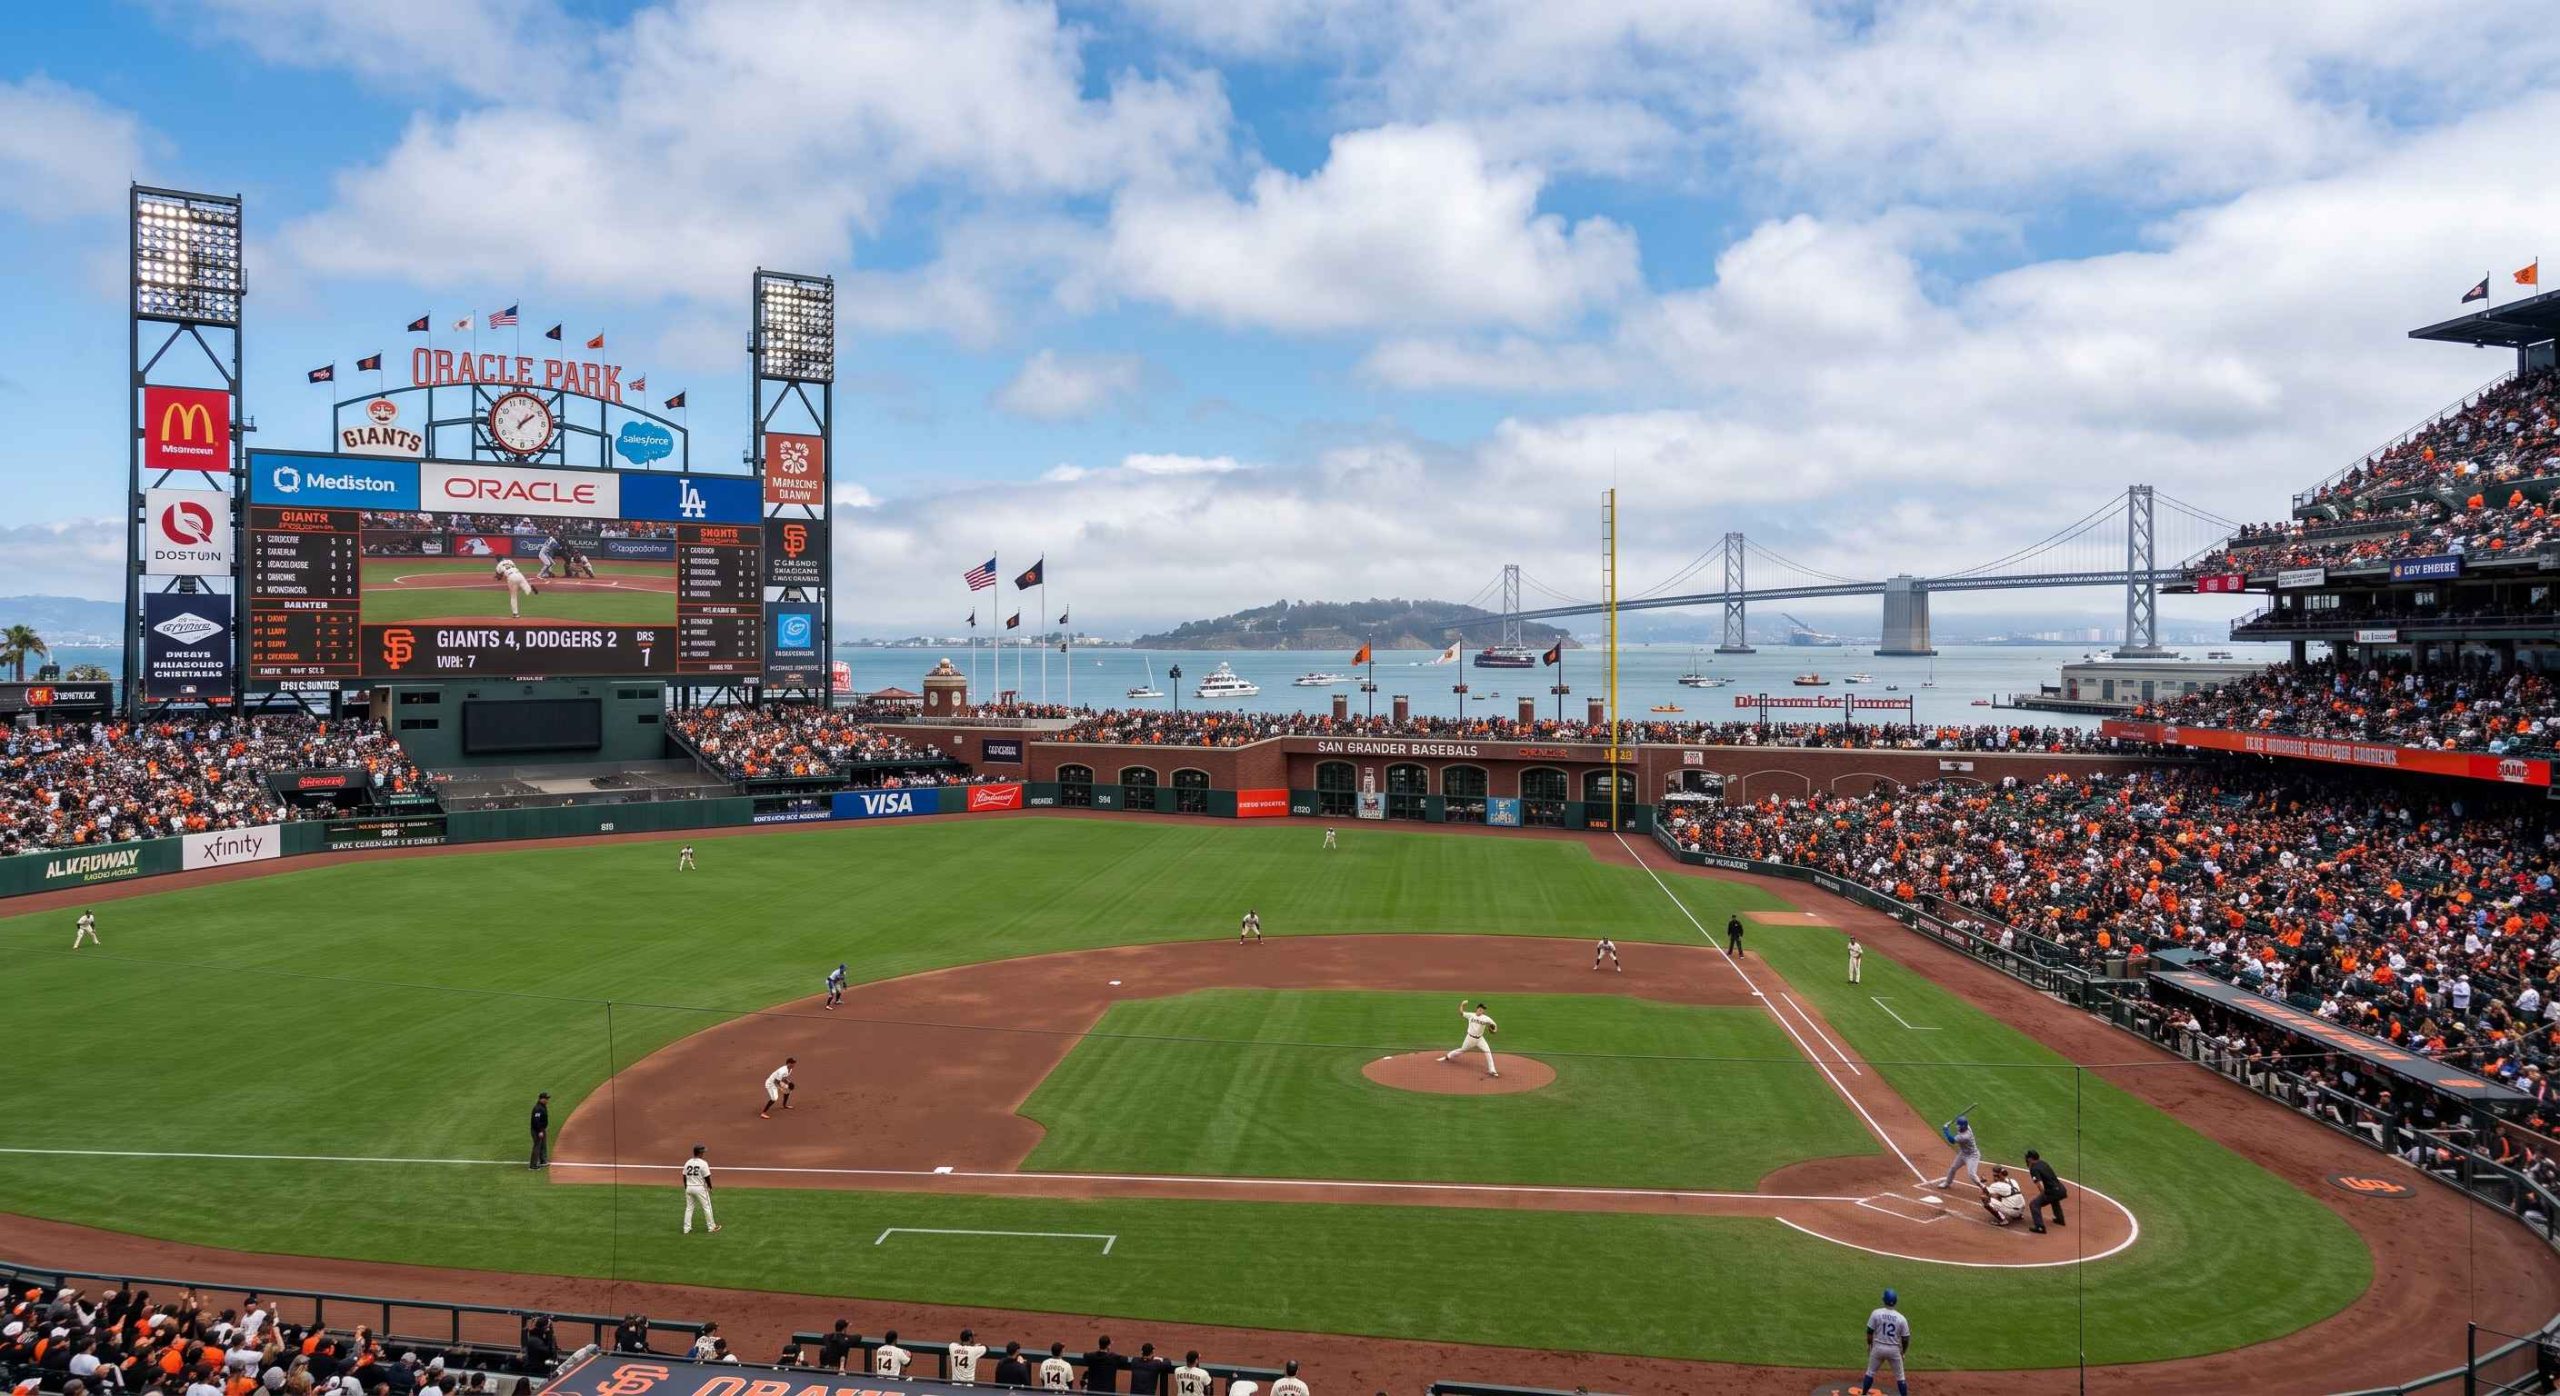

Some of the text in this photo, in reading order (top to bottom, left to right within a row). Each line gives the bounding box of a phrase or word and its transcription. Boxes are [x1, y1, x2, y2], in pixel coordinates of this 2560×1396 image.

[412, 348, 623, 405] ORACLE PARK
[342, 427, 422, 452] GIANTS
[444, 477, 596, 504] ORACLE
[679, 479, 706, 518] LA
[437, 630, 617, 650] GIANTS 4, DODGERS 2
[637, 631, 654, 642] DRS
[467, 655, 476, 668] 7
[1318, 741, 1343, 753] SAN
[860, 793, 913, 814] VISA
[204, 834, 263, 862] xfinity
[1882, 1322, 1896, 1337] 12
[878, 1358, 892, 1371] 14
[954, 1356, 968, 1369] 14
[1046, 1372, 1060, 1385] 14
[1181, 1381, 1195, 1393] 14
